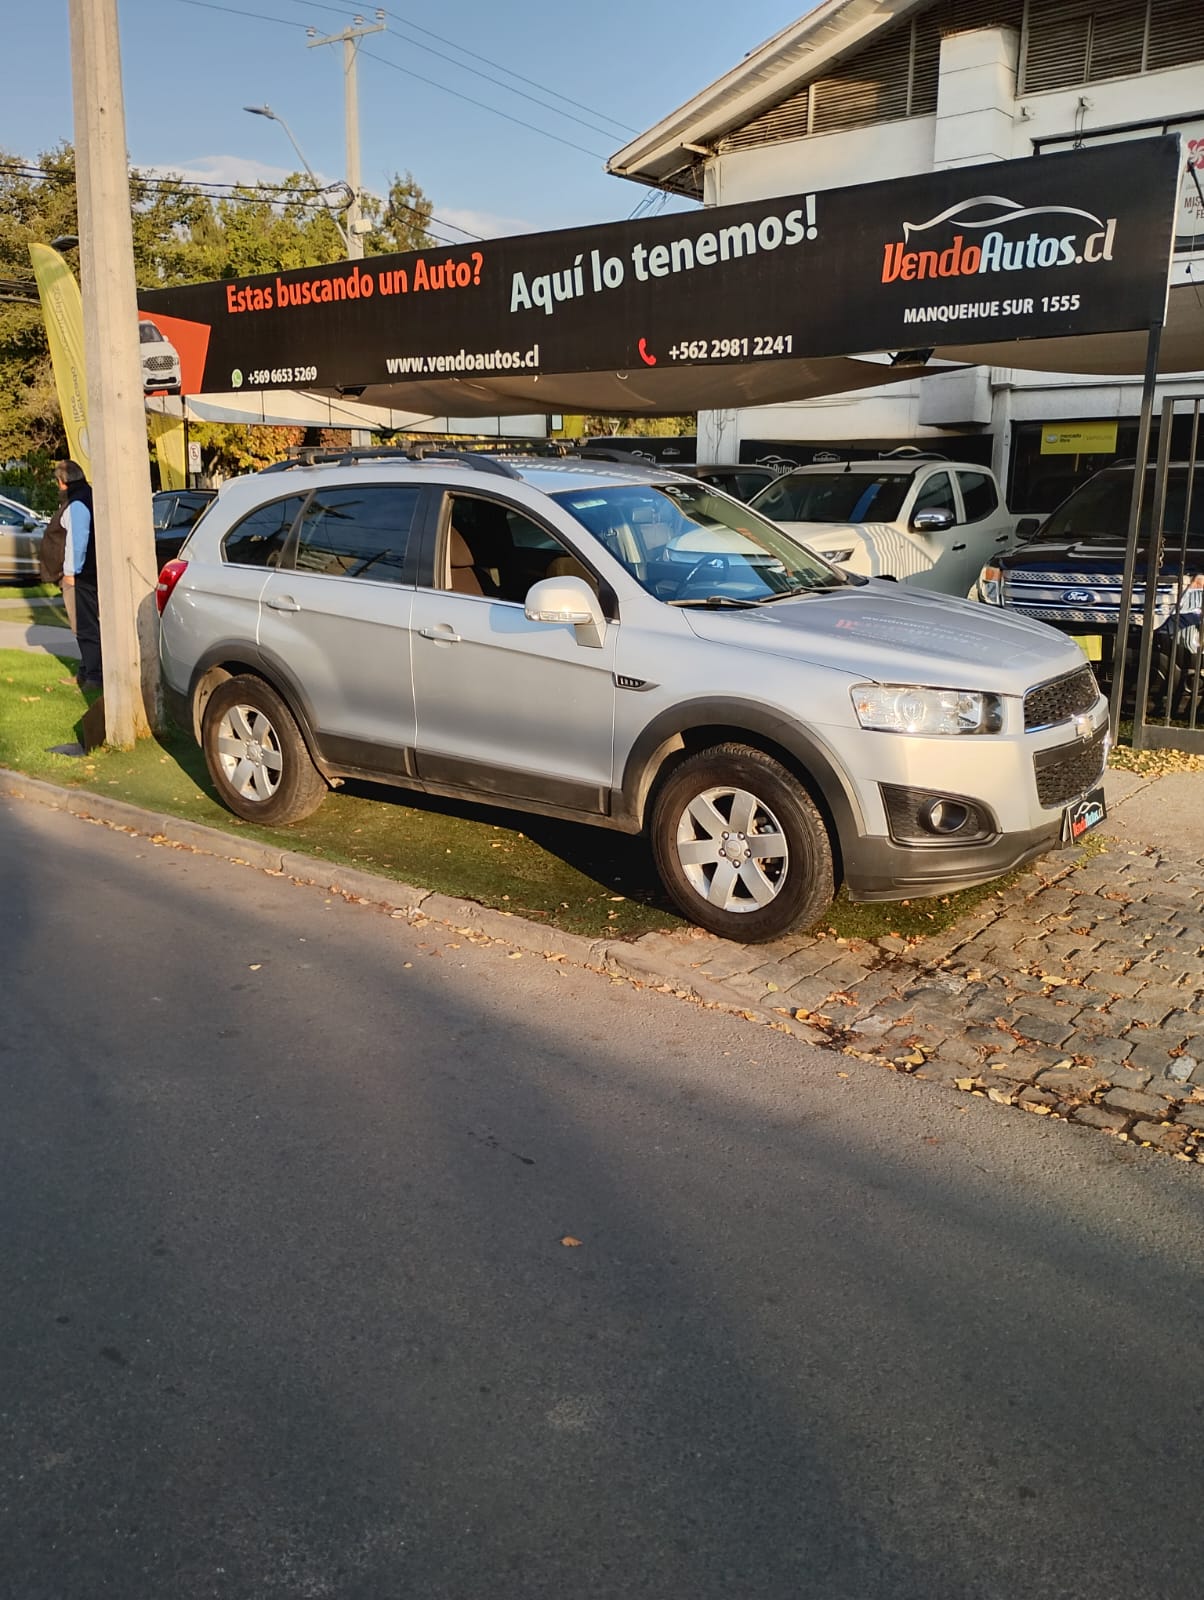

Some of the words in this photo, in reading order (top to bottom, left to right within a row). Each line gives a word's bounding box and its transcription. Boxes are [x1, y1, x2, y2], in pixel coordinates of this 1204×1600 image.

[510, 254, 584, 315] Aquí
[591, 250, 625, 292] lo
[632, 194, 818, 282] tenemos!
[881, 218, 1117, 283] VendoAutos.cl
[226, 285, 273, 313] Estas
[275, 266, 374, 308] buscando
[379, 269, 408, 295] un
[413, 252, 484, 292] Auto?
[903, 301, 999, 323] MANQUEHUE
[1002, 299, 1034, 315] SUR
[1041, 294, 1081, 313] 1555
[386, 344, 539, 374] www.vendoautos.cl
[669, 340, 708, 360] +562
[711, 338, 749, 357] 2981
[753, 335, 793, 355] 2241
[248, 370, 270, 384] +569
[271, 368, 293, 383] 6653
[294, 366, 318, 382] 5269
[1067, 591, 1089, 601] Ford
